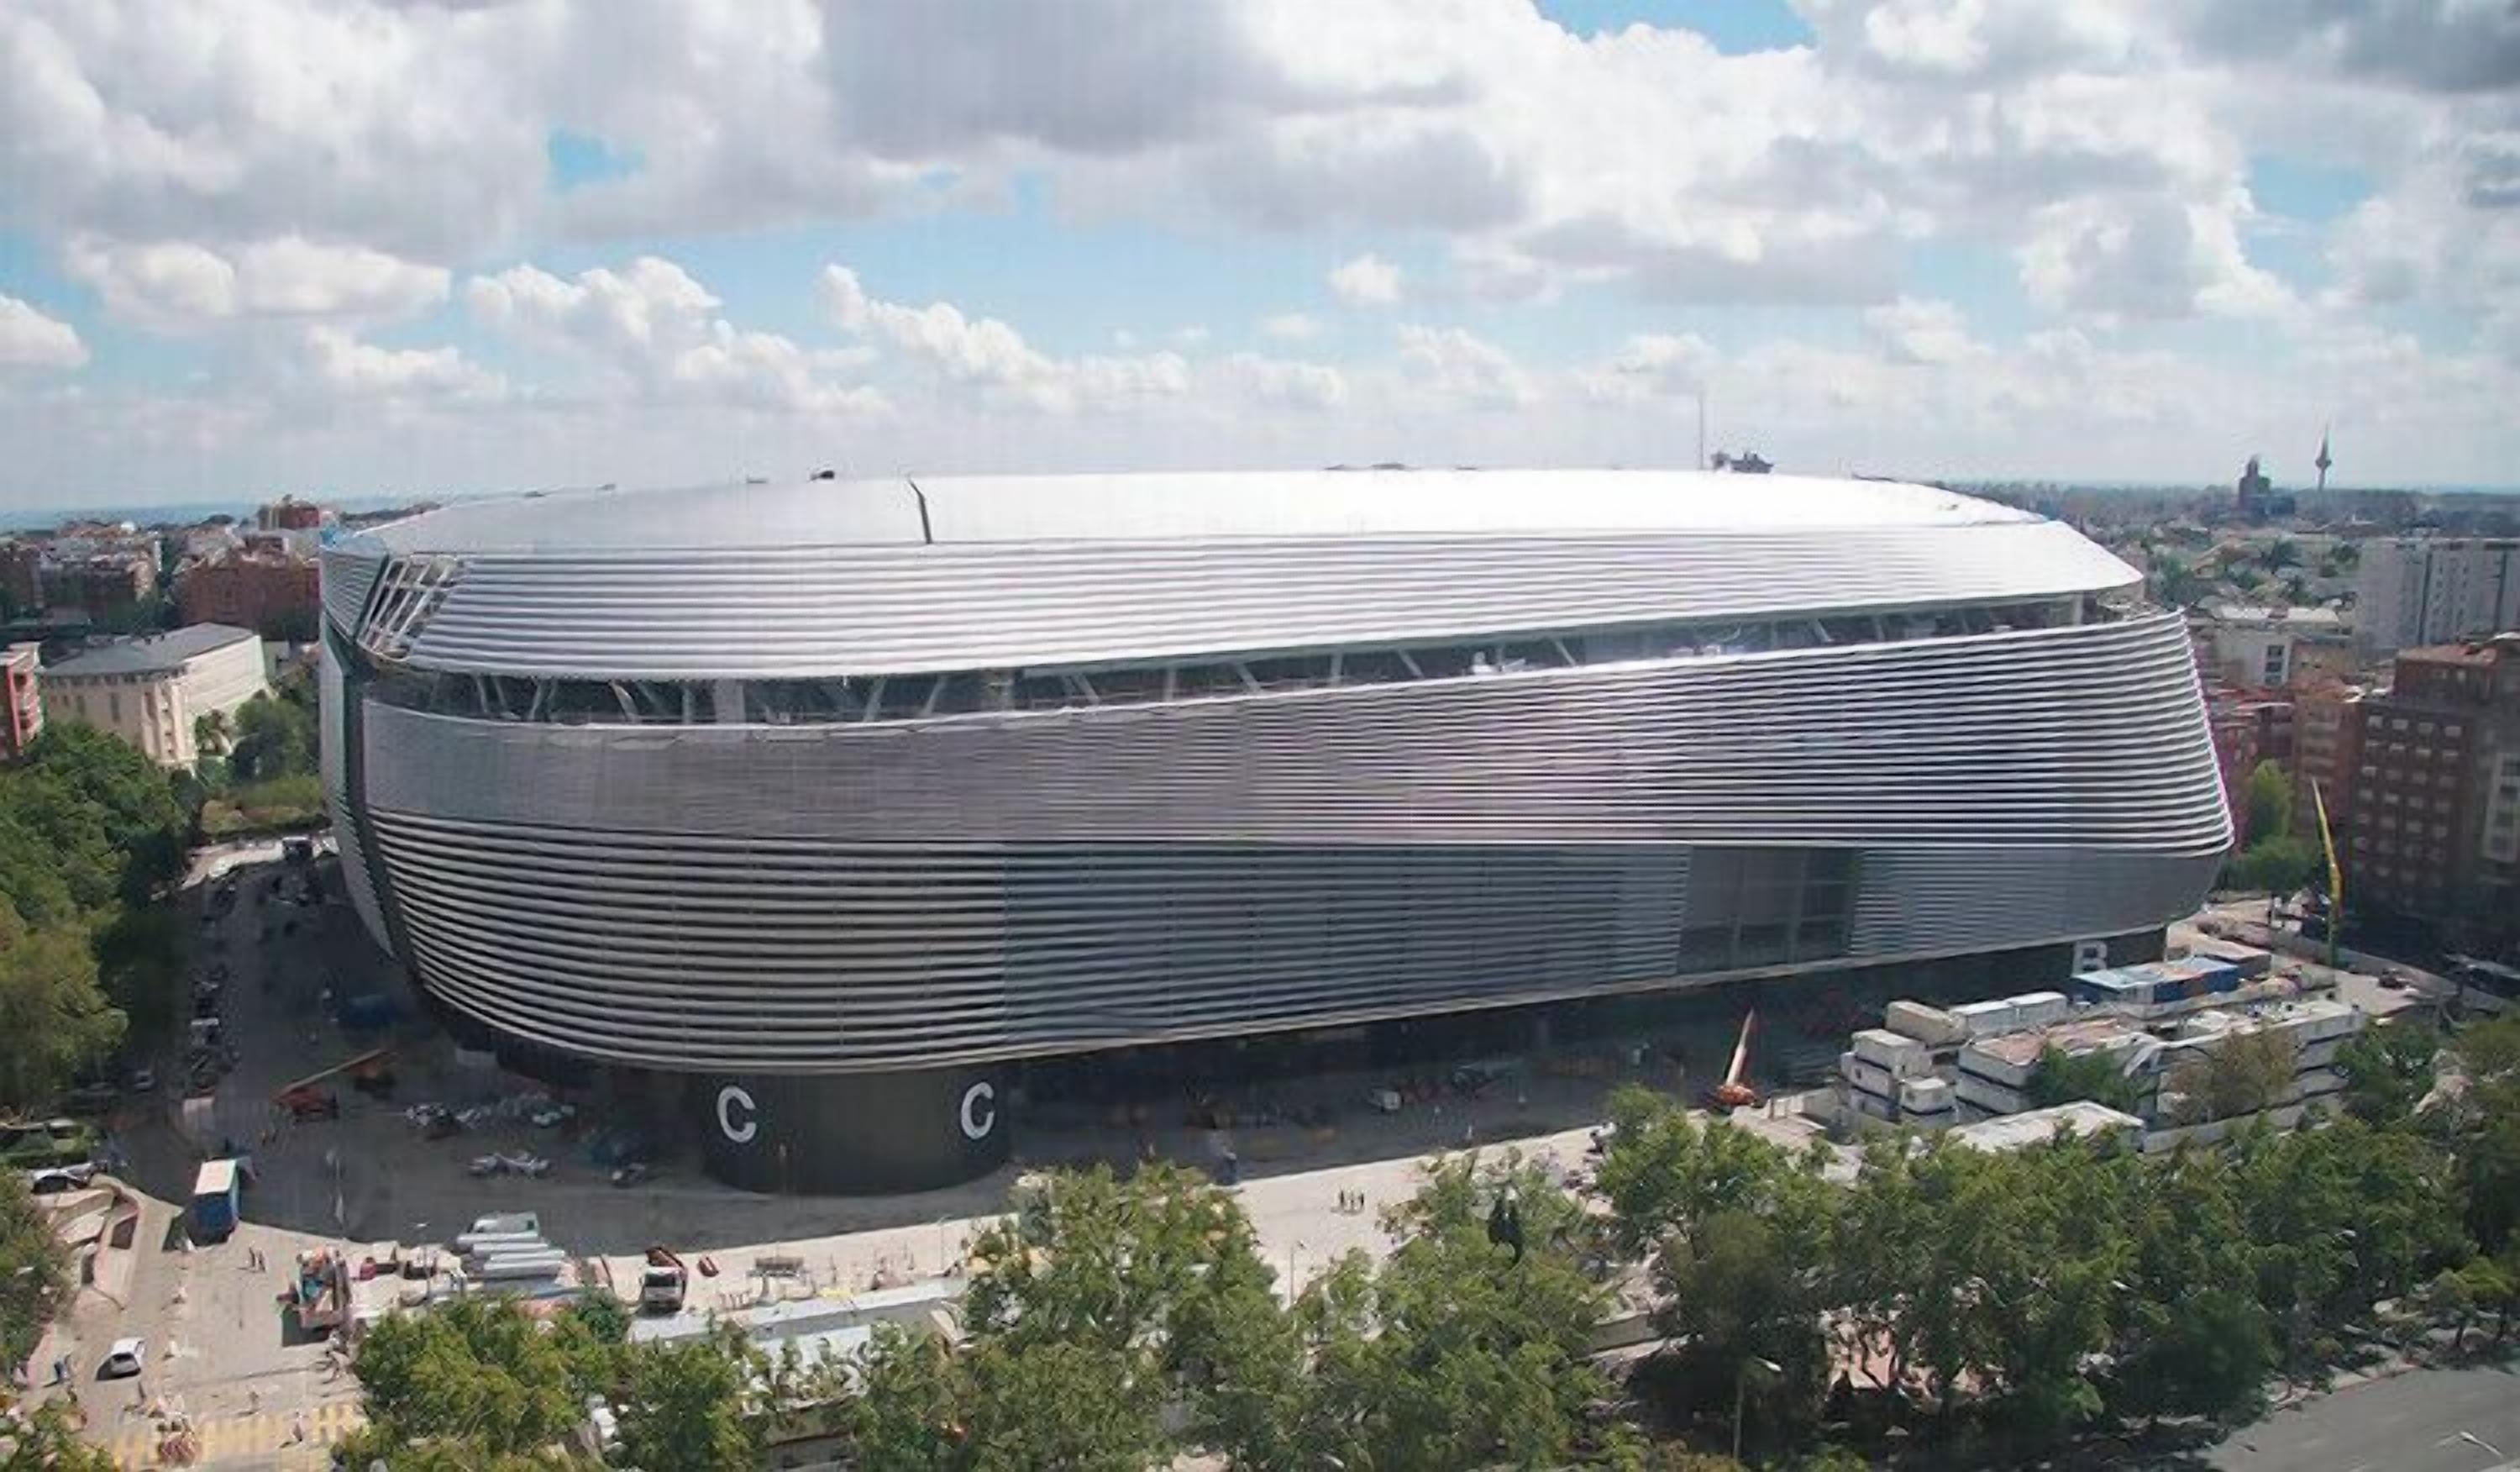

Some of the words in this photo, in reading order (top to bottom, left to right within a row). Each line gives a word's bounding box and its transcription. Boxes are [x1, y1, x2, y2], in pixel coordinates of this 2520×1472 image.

[2072, 940, 2108, 975] B
[717, 1086, 757, 1143] C
[961, 1082, 995, 1139] C
